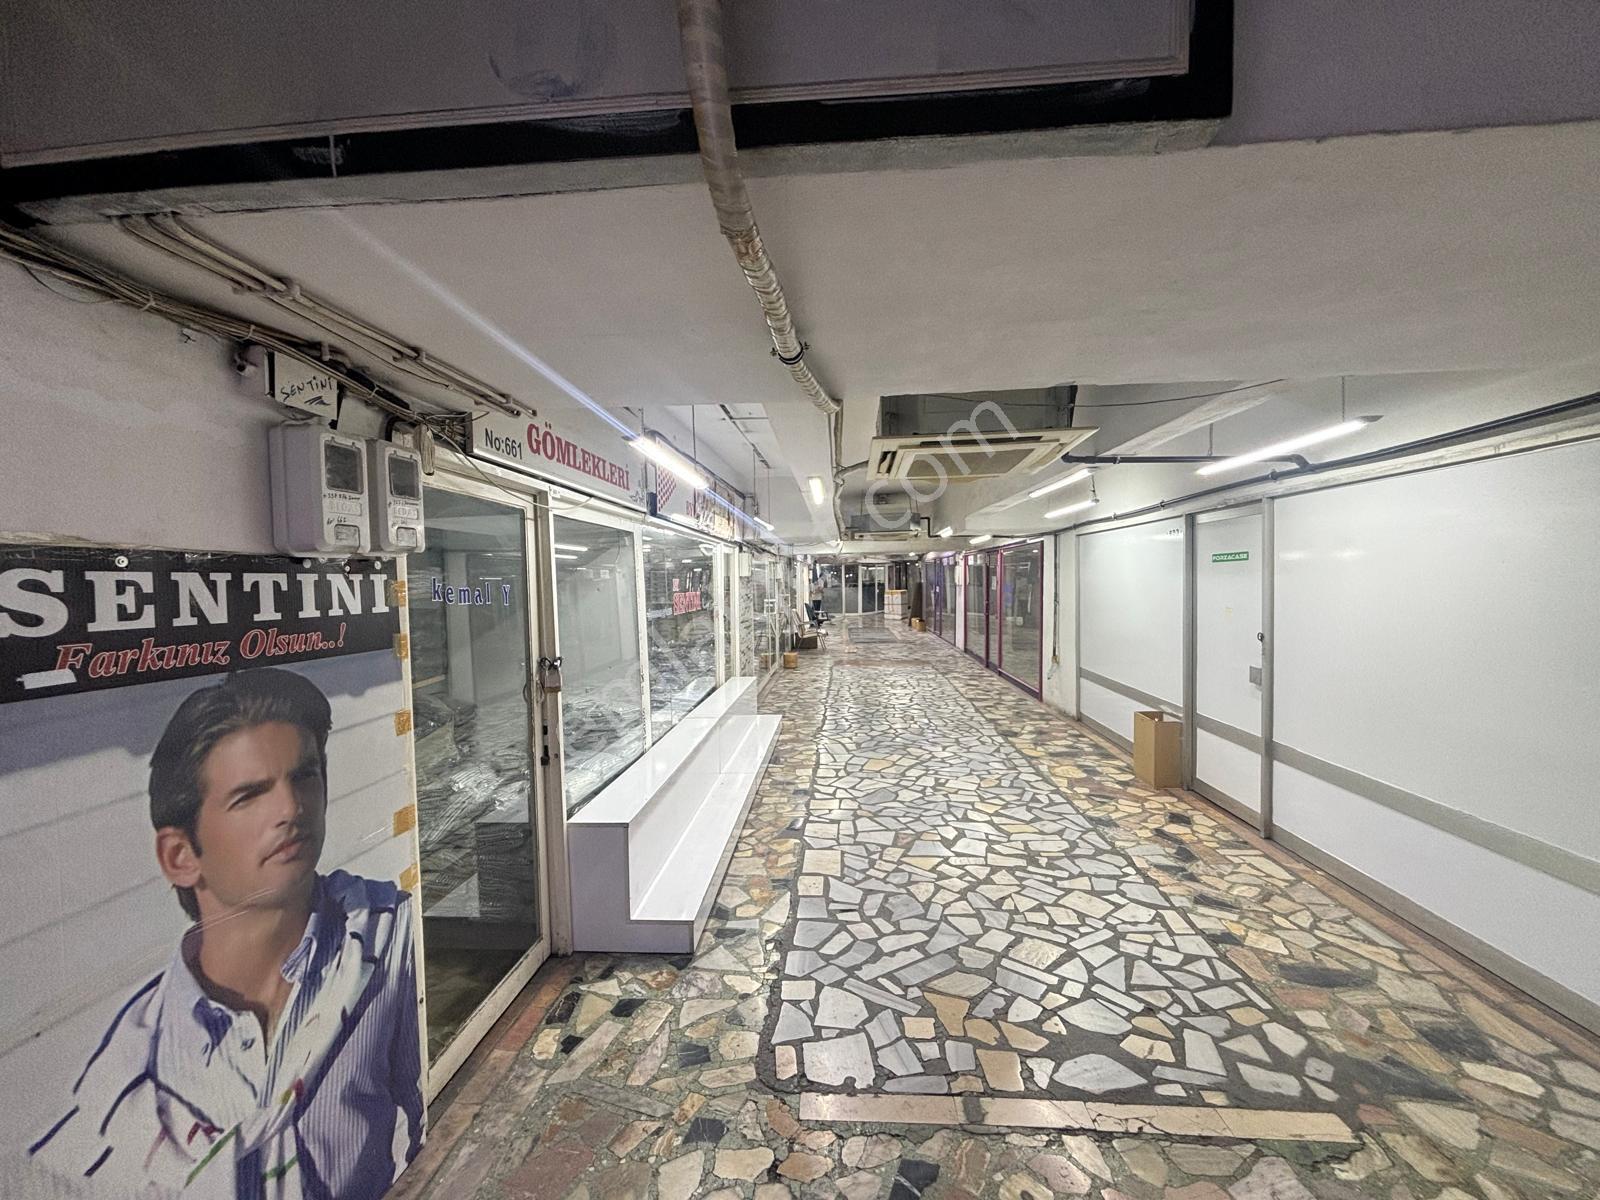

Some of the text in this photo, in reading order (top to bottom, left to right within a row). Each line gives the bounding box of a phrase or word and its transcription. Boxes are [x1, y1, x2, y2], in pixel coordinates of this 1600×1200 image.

[484, 421, 631, 491] No:661 GÖMLEKLERİ
[431, 576, 511, 606] kemal Y
[56, 638, 231, 679] Farkınız
